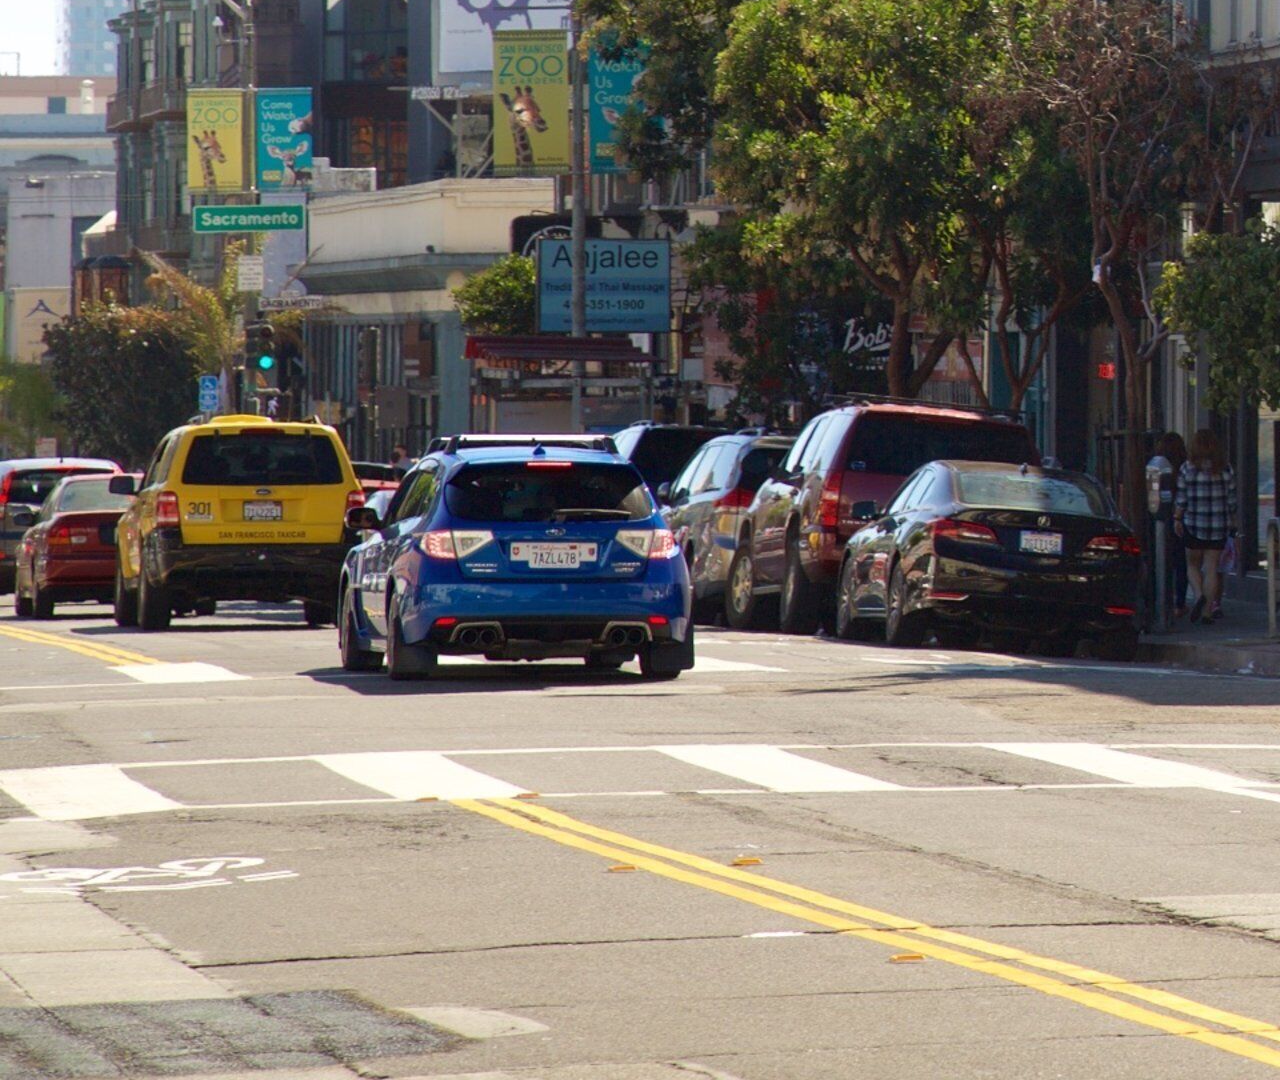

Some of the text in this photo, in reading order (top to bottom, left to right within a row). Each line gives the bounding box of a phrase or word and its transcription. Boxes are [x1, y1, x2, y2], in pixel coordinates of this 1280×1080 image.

[500, 44, 563, 53] SAN FRANCISCO
[499, 56, 564, 76] ZOO
[594, 59, 642, 73] Watch
[510, 76, 563, 84] GARDENS
[594, 76, 613, 88] Us
[261, 99, 293, 109] Come
[192, 108, 239, 123] ZOO
[261, 110, 296, 120] Watch
[261, 123, 275, 132] Us
[261, 133, 293, 144] Grow
[201, 211, 299, 226] Sacramento
[563, 299, 645, 310] 4-351-1900
[188, 502, 211, 515] 301
